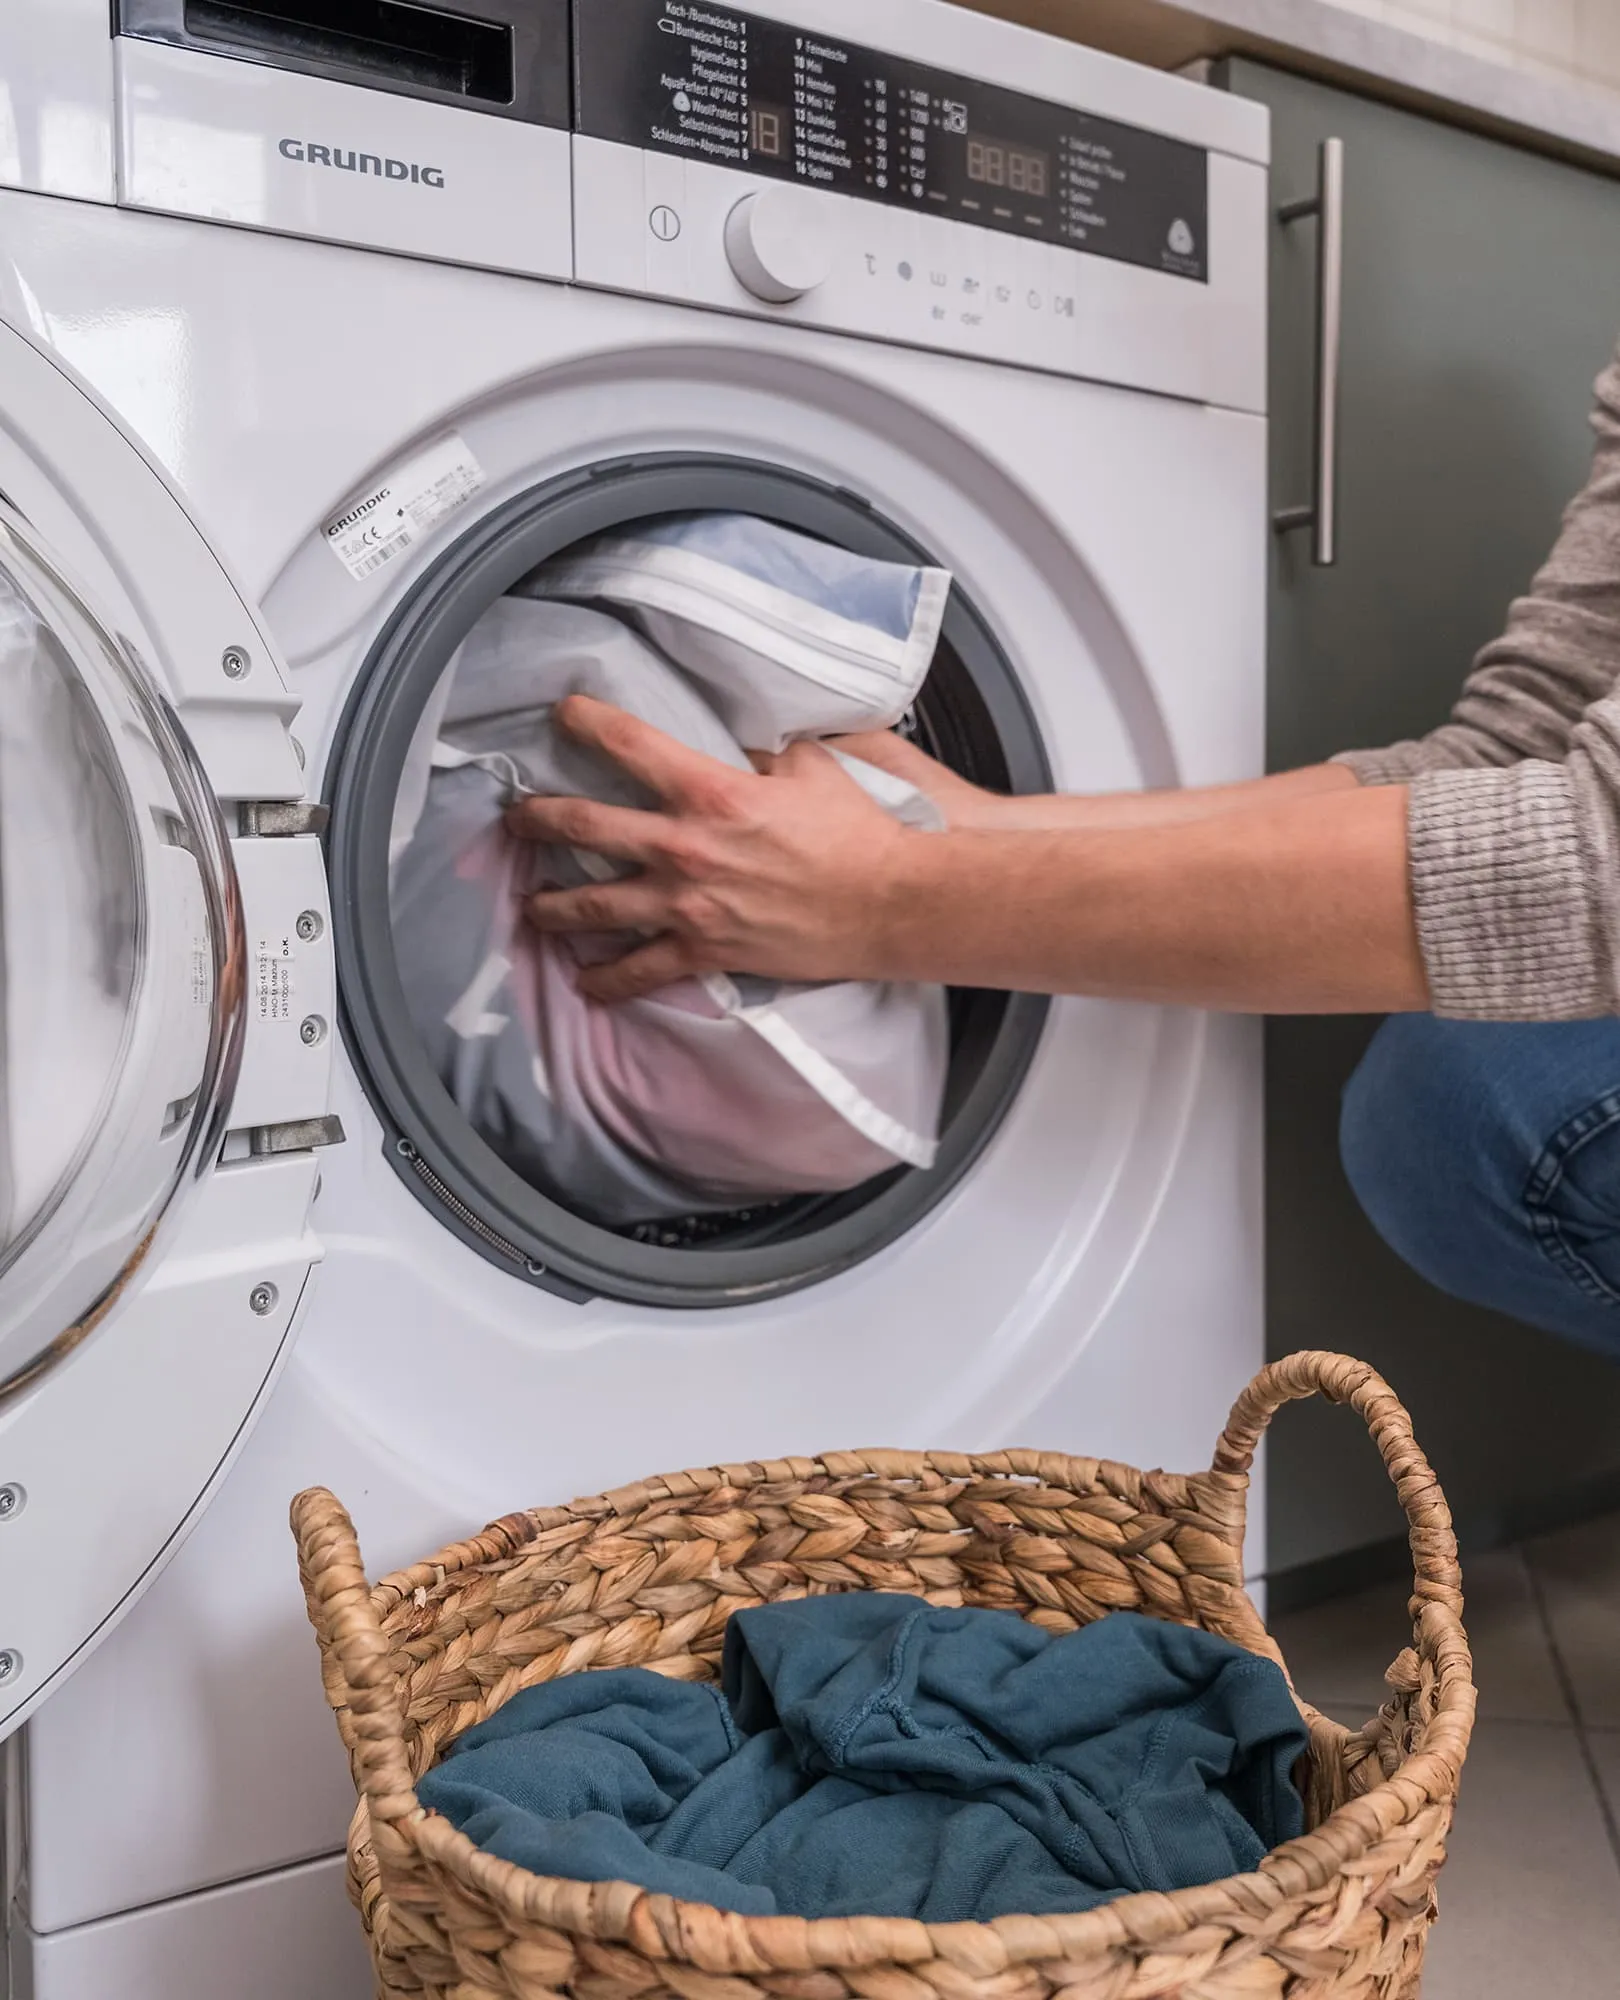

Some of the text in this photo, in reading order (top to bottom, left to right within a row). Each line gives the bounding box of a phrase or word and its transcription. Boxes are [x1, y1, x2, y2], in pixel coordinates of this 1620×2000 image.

[740, 21, 747, 35] 1
[676, 22, 748, 53] Buntwäsche Eco 2
[795, 38, 803, 50] 9
[691, 44, 748, 71] HygieneCare 3
[794, 55, 805, 69] 10
[691, 63, 748, 89] Pflegeleicht 4
[794, 73, 804, 87] 11
[661, 73, 708, 96] AquaPerfect
[740, 93, 748, 107] 5
[794, 91, 805, 104] 12
[691, 100, 748, 125] WoolProtect 6
[795, 108, 806, 122] 13
[679, 115, 748, 143] Selbstreinigung 7
[795, 126, 806, 139] 14
[741, 147, 749, 160] 8
[795, 144, 806, 158] 15
[278, 138, 445, 189] GRUNDIG
[796, 161, 807, 175] 16
[328, 487, 391, 537] GRUNDIG
